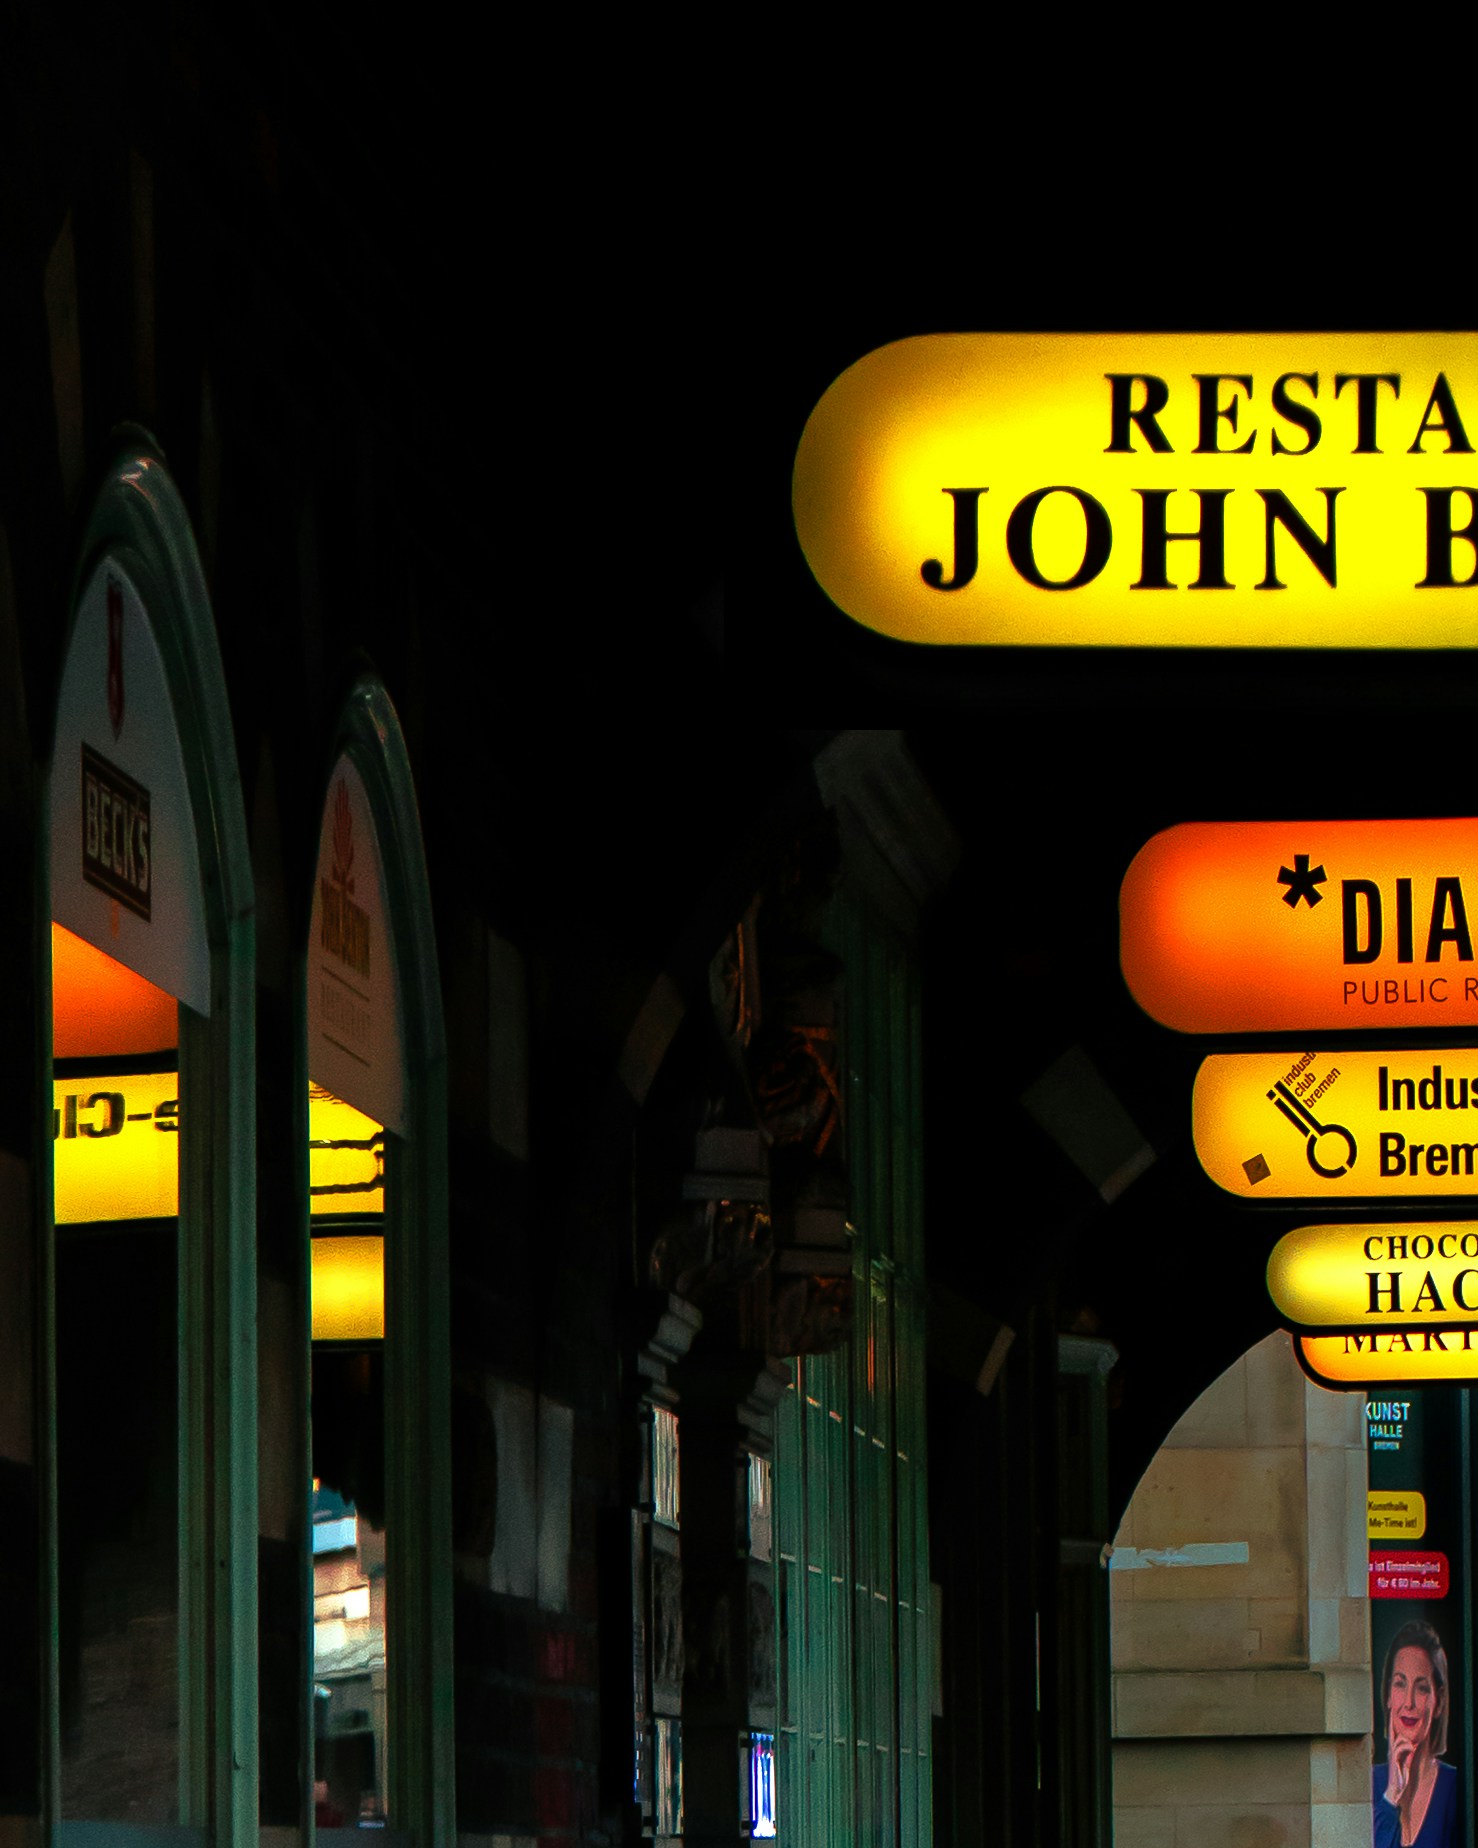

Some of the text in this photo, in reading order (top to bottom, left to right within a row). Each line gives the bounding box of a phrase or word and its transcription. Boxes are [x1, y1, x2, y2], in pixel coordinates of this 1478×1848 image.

[920, 485, 1347, 592] JOHN
[1343, 977, 1449, 1005] PUBLIC
[1294, 1072, 1317, 1098] club
[1302, 1067, 1342, 1109] bremen
[1369, 1424, 1403, 1438] HALLE
